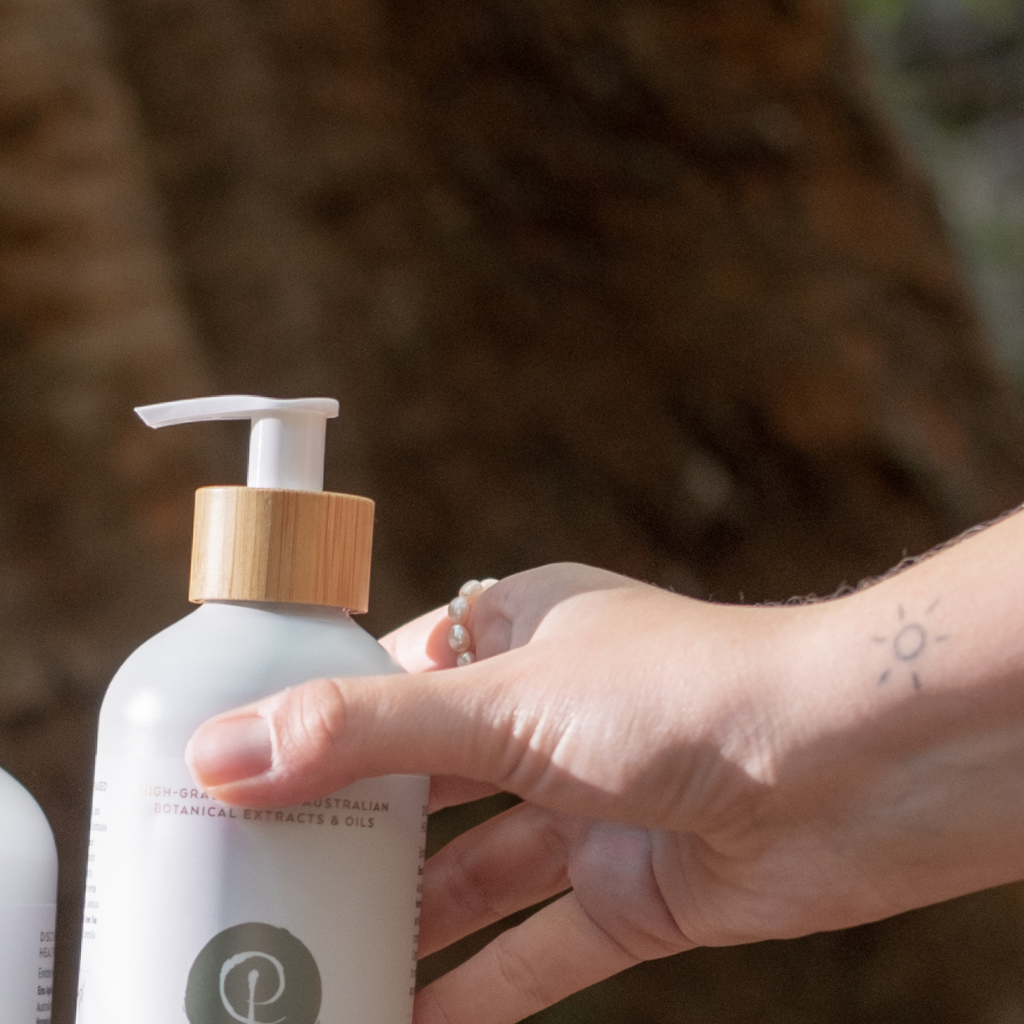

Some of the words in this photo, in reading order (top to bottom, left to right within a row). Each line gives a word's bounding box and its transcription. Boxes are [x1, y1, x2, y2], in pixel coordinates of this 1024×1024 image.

[139, 786, 217, 800] HIGH-GRA
[154, 803, 237, 818] BOTANICAL
[243, 809, 324, 825] EXTRACTS
[330, 815, 339, 826] &
[345, 816, 375, 828] OILS
